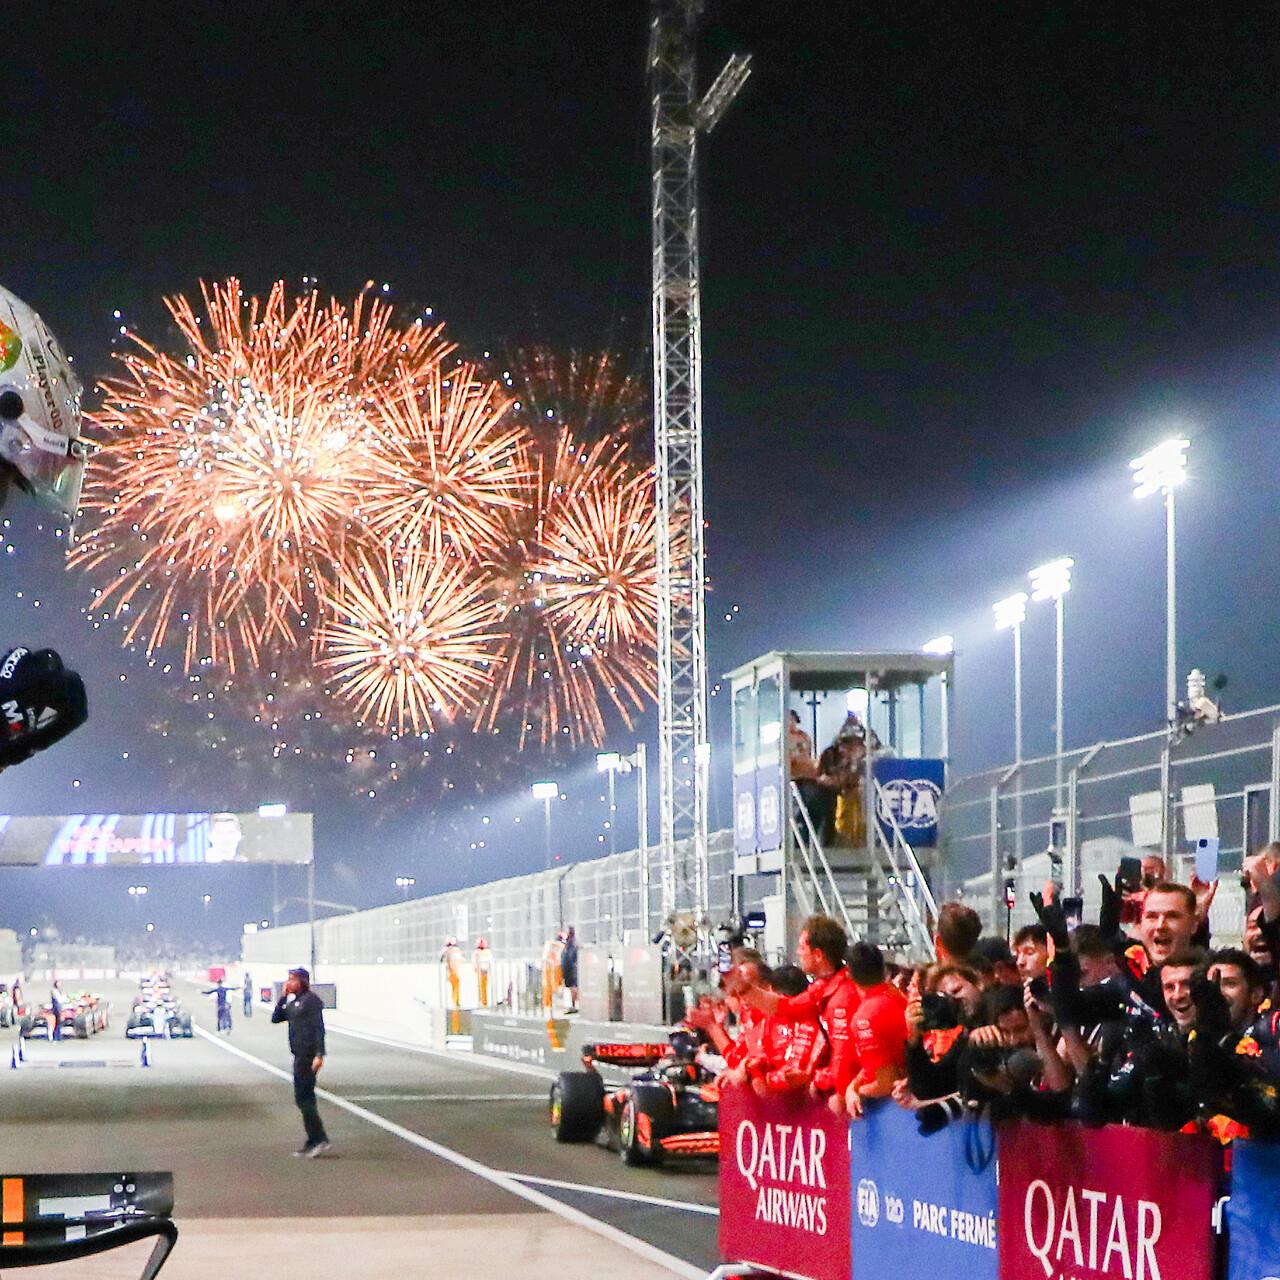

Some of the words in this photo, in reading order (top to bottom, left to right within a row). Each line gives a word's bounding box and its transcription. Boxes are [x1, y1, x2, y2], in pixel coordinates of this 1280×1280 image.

[879, 785, 939, 820] FIA
[736, 1119, 827, 1190] QATAR
[755, 1188, 827, 1236] AIRWAYS
[857, 1185, 877, 1221] FIA
[913, 1200, 948, 1236] PARC
[951, 1209, 996, 1249] FERMÉ
